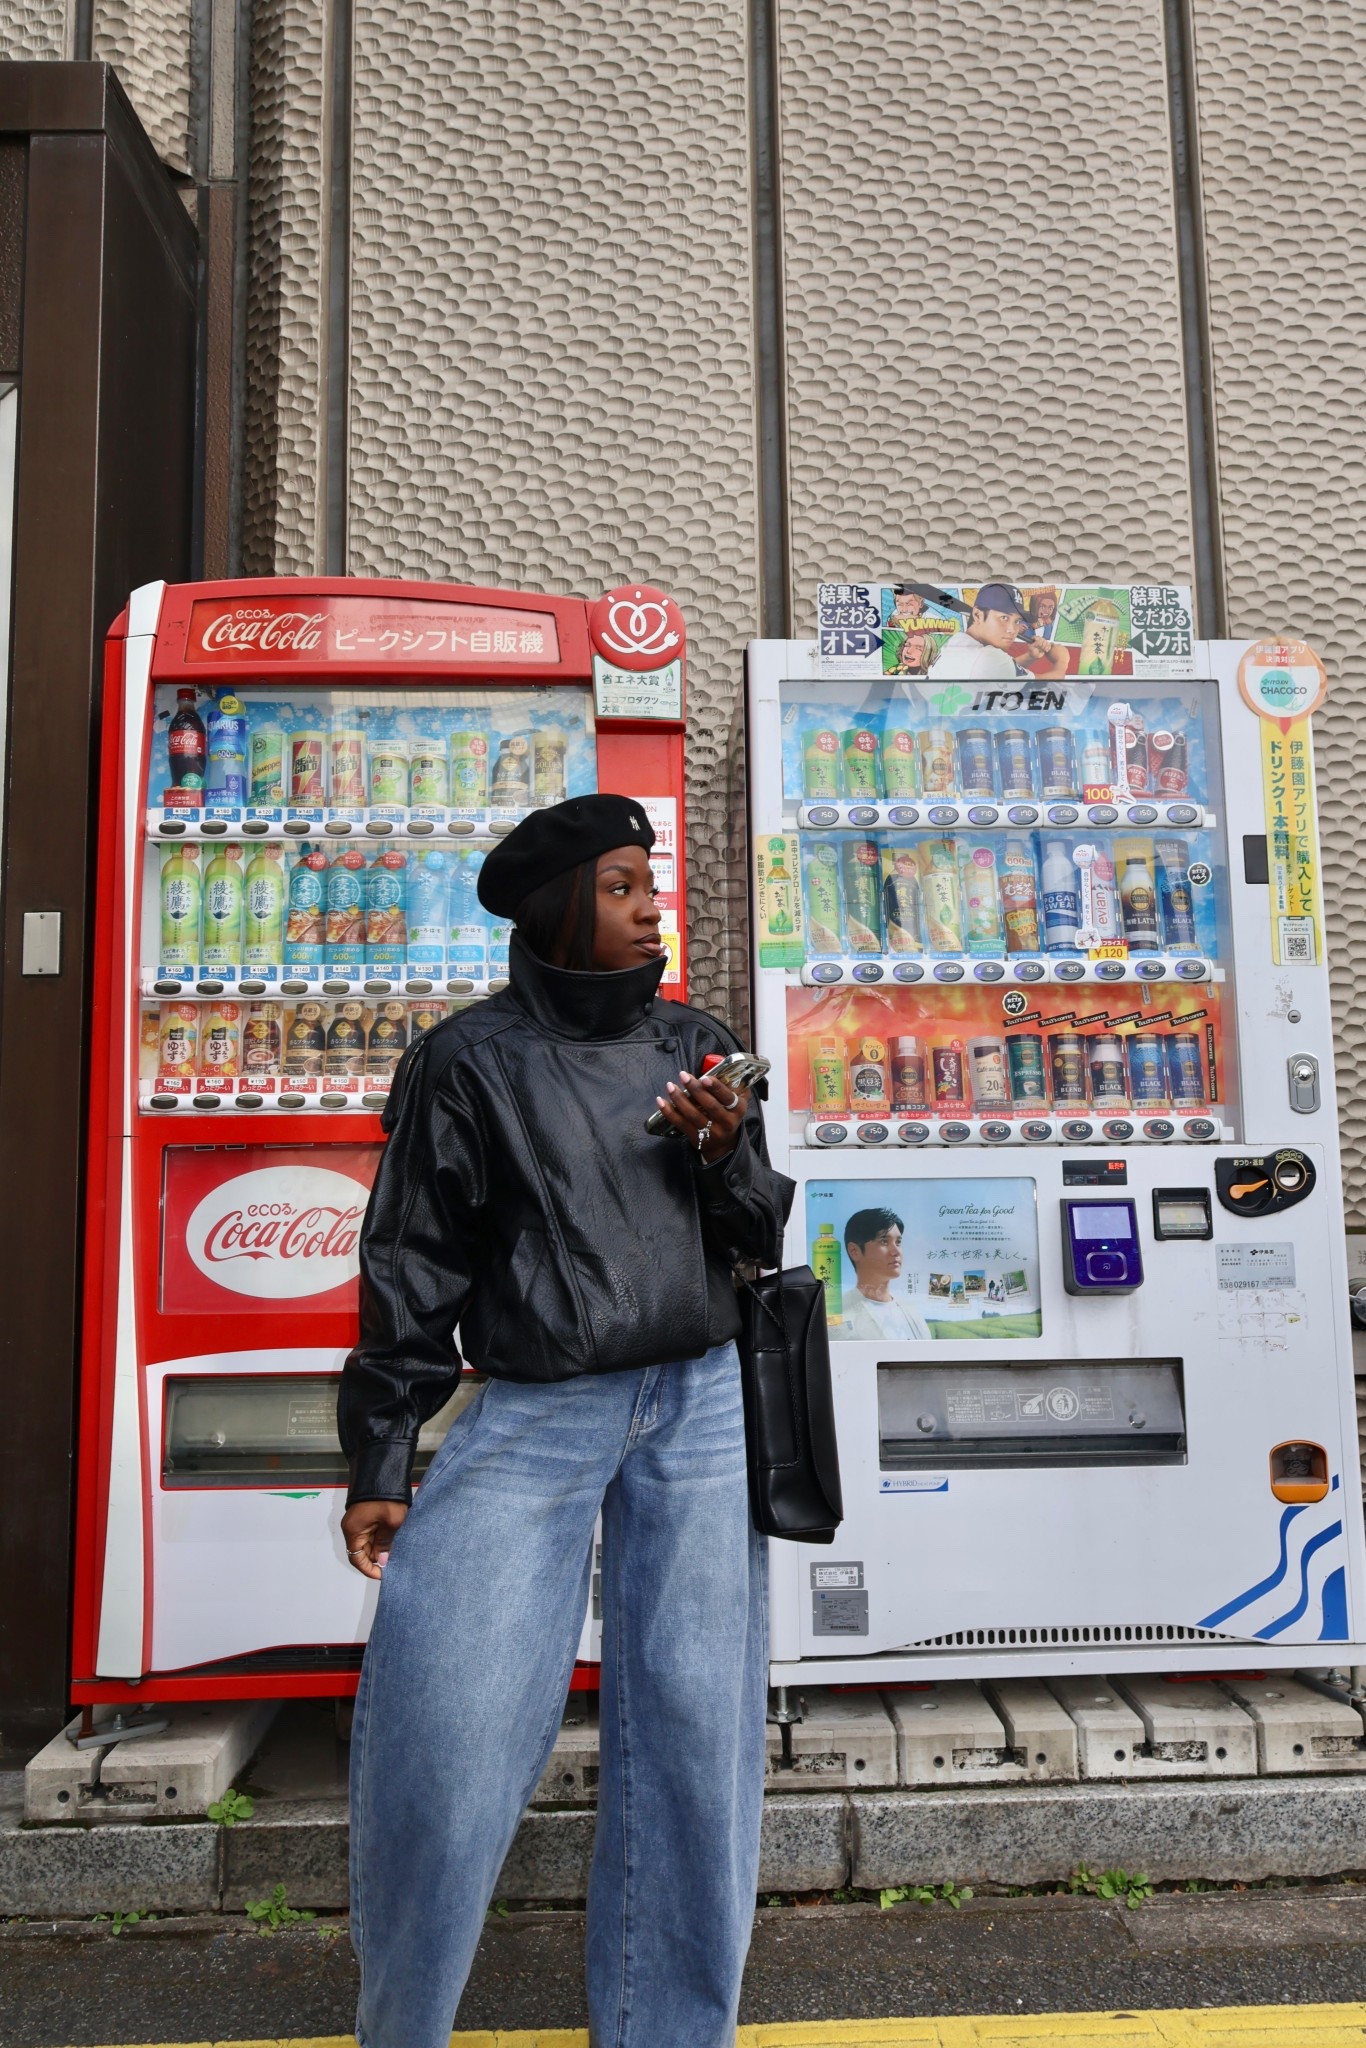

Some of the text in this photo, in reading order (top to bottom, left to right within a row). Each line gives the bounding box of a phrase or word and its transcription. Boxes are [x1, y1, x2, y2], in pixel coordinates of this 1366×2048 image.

[821, 585, 867, 605] 結果に
[1013, 588, 1023, 605] LA
[1131, 586, 1176, 607] 結果に
[821, 606, 877, 626] こだわる
[1133, 608, 1187, 627] こだわる
[202, 612, 329, 652] Coca-Cola
[336, 628, 544, 654] ピークシフト自販機
[823, 631, 871, 655] オトコ
[1143, 632, 1190, 655] トクホ
[1255, 645, 1305, 654] 伊藤園アプリ
[1266, 656, 1296, 664] 決済対応
[602, 674, 660, 687] 省エネ大賞
[1260, 686, 1307, 695] CHACOCO
[602, 695, 659, 705] エコプロダクツ
[972, 691, 1067, 711] ITO EN
[602, 704, 620, 714] 大賞
[296, 754, 317, 767] REAL
[295, 762, 317, 775] GOLD
[336, 763, 357, 775] GOLD
[1271, 740, 1290, 860] ドリンク1本無料
[1289, 740, 1312, 912] 伊藤園アプリで購入して
[1006, 857, 1032, 866] 600ml
[298, 877, 311, 904] 麦茶
[335, 877, 349, 904] 麦茶
[376, 877, 390, 904] 麦茶
[757, 853, 767, 920] 体脂肪がつきにくい
[791, 839, 802, 932] 血中コレステロールを減らす
[1004, 882, 1033, 896] むぎ茶
[170, 879, 187, 911] 綾鷹
[212, 879, 229, 911] 綾鷹
[253, 879, 270, 911] 綾鷹
[1095, 891, 1108, 925] evian
[1094, 948, 1123, 958] ¥120
[1022, 1013, 1039, 1022] COFFEE
[1057, 1013, 1075, 1022] COFFEE
[1090, 1013, 1107, 1022] COFFEE
[1123, 1013, 1140, 1021] COFFEE
[1154, 1013, 1170, 1021] COFFEE
[1189, 1011, 1206, 1020] COFFEE
[167, 1041, 179, 1062] ゆず
[209, 1041, 221, 1062] ゆず
[870, 1050, 879, 1060] 0
[857, 1078, 881, 1088] 黒豆茶
[1099, 1083, 1122, 1091] BLACK
[896, 1091, 924, 1099] COCOA
[1108, 1161, 1125, 1170] 販売中
[1233, 1158, 1264, 1167] おつり・返却
[938, 1203, 1015, 1217] Green Tea for Good
[204, 1206, 367, 1262] Coca-Cola
